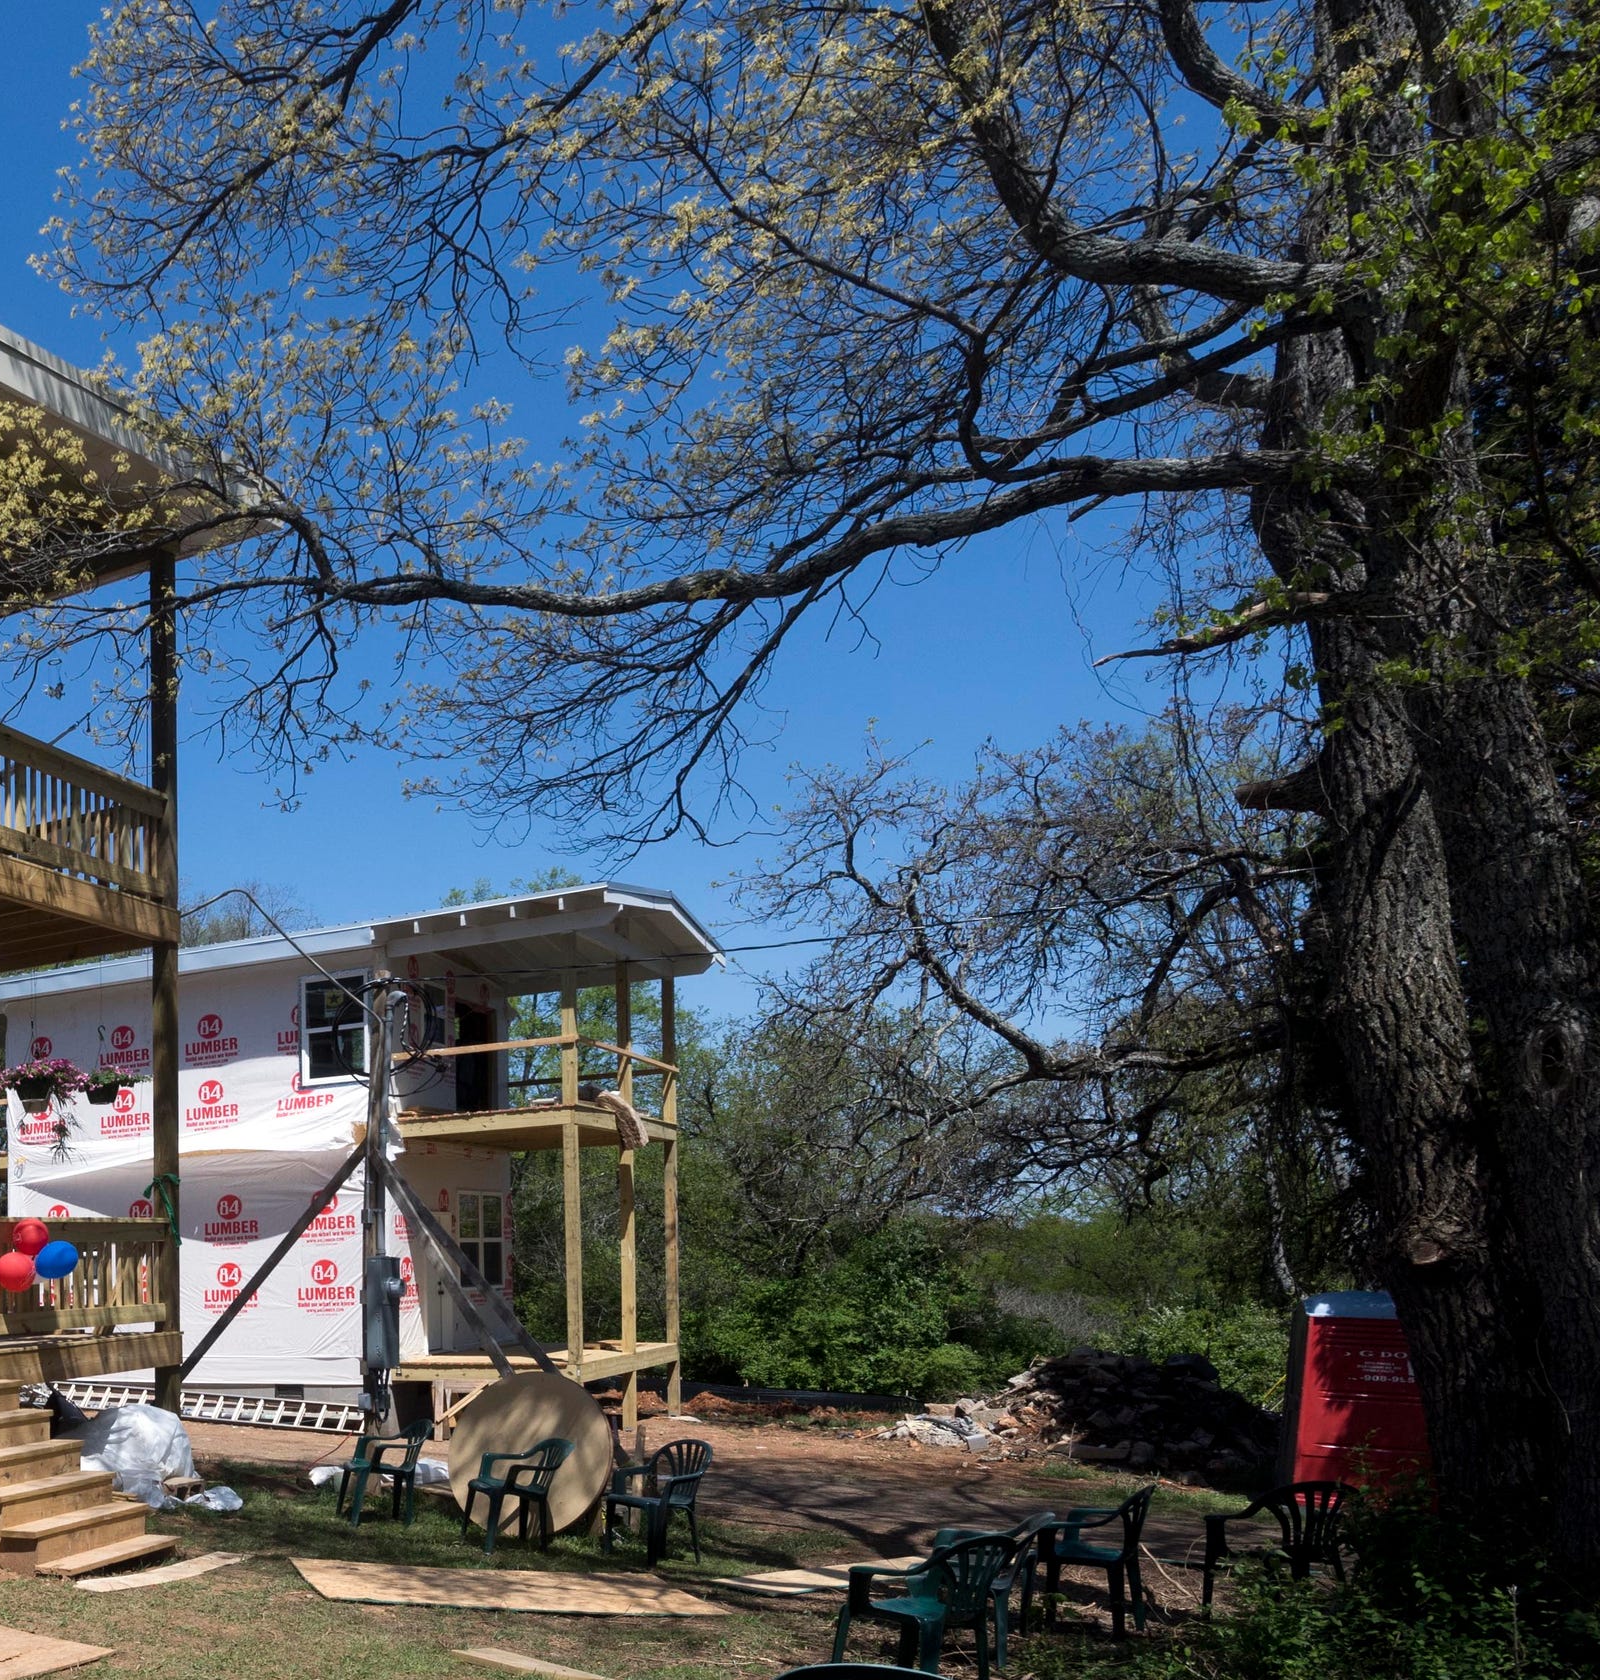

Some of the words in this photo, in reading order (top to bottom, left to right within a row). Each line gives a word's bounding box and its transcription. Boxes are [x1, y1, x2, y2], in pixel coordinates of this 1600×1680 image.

[199, 1019, 220, 1035] 84
[113, 1030, 134, 1046] 84
[185, 1037, 238, 1056] LUMBER
[100, 1049, 150, 1066] LUMBER
[199, 1085, 222, 1101] 84
[113, 1095, 134, 1109] 84
[277, 1094, 334, 1111] LUMBER
[101, 1112, 150, 1128] LUMBER
[186, 1104, 239, 1121] LUMBER
[131, 1205, 151, 1217] 84
[219, 1199, 241, 1216] 84
[205, 1220, 258, 1236] LUMBER
[306, 1215, 355, 1231] UMBER
[219, 1268, 240, 1283] 84
[313, 1264, 336, 1281] 84
[298, 1286, 355, 1301] LUMBER
